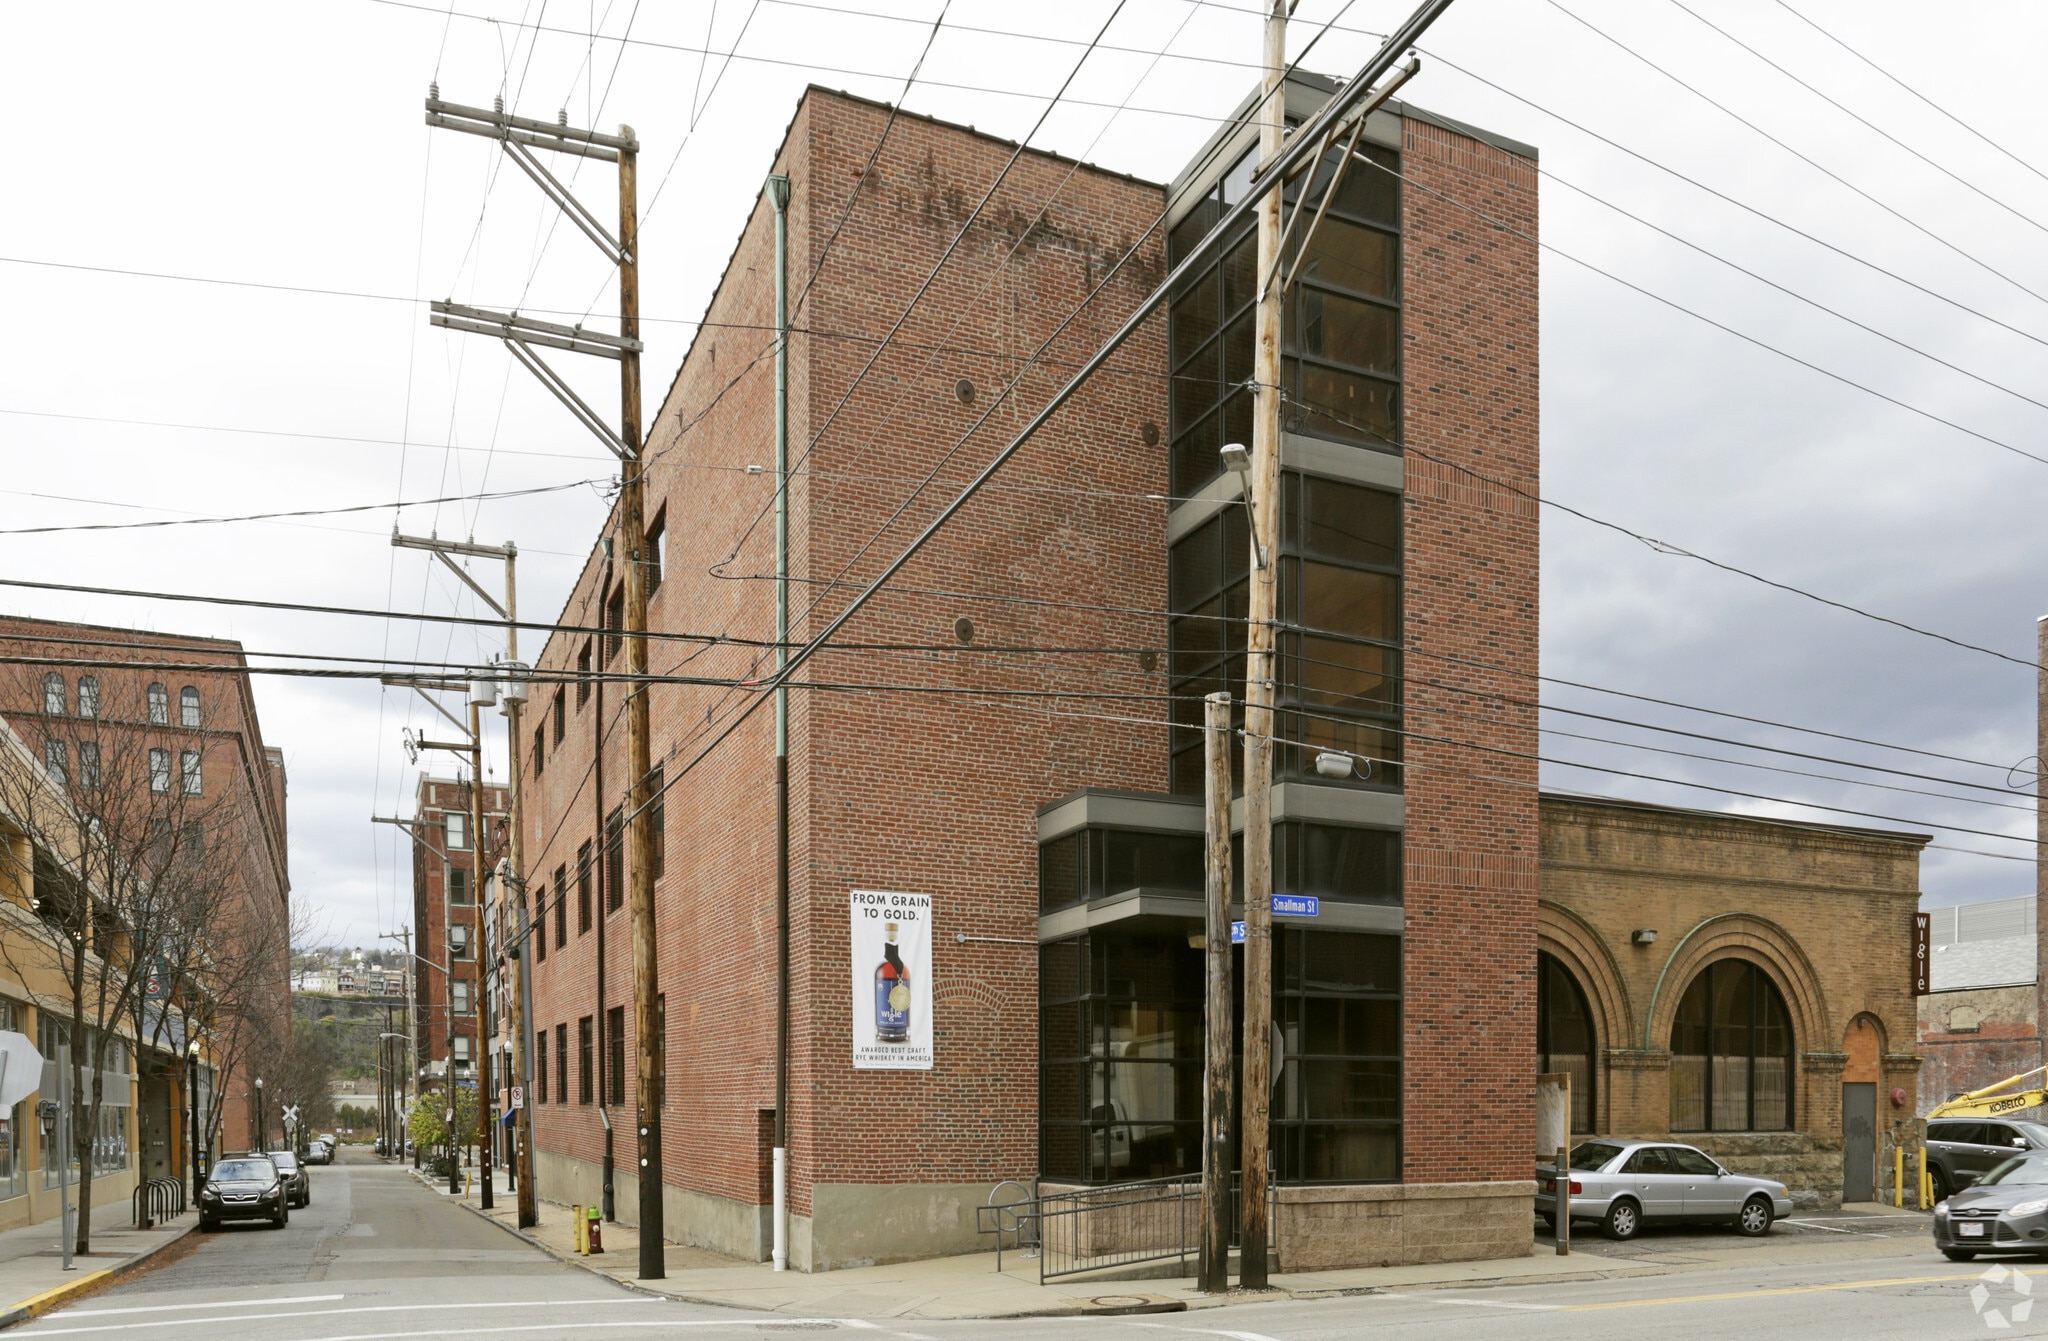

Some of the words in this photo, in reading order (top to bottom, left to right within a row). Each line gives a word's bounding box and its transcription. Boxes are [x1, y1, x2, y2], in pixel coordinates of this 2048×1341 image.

[853, 893, 886, 905] FROM
[891, 895, 929, 907] GRAIN
[1273, 898, 1306, 912] Smallman
[1307, 900, 1315, 913] St
[864, 908, 879, 919] TO
[884, 909, 919, 920] GOLD.
[861, 1046, 889, 1054] AWARDED
